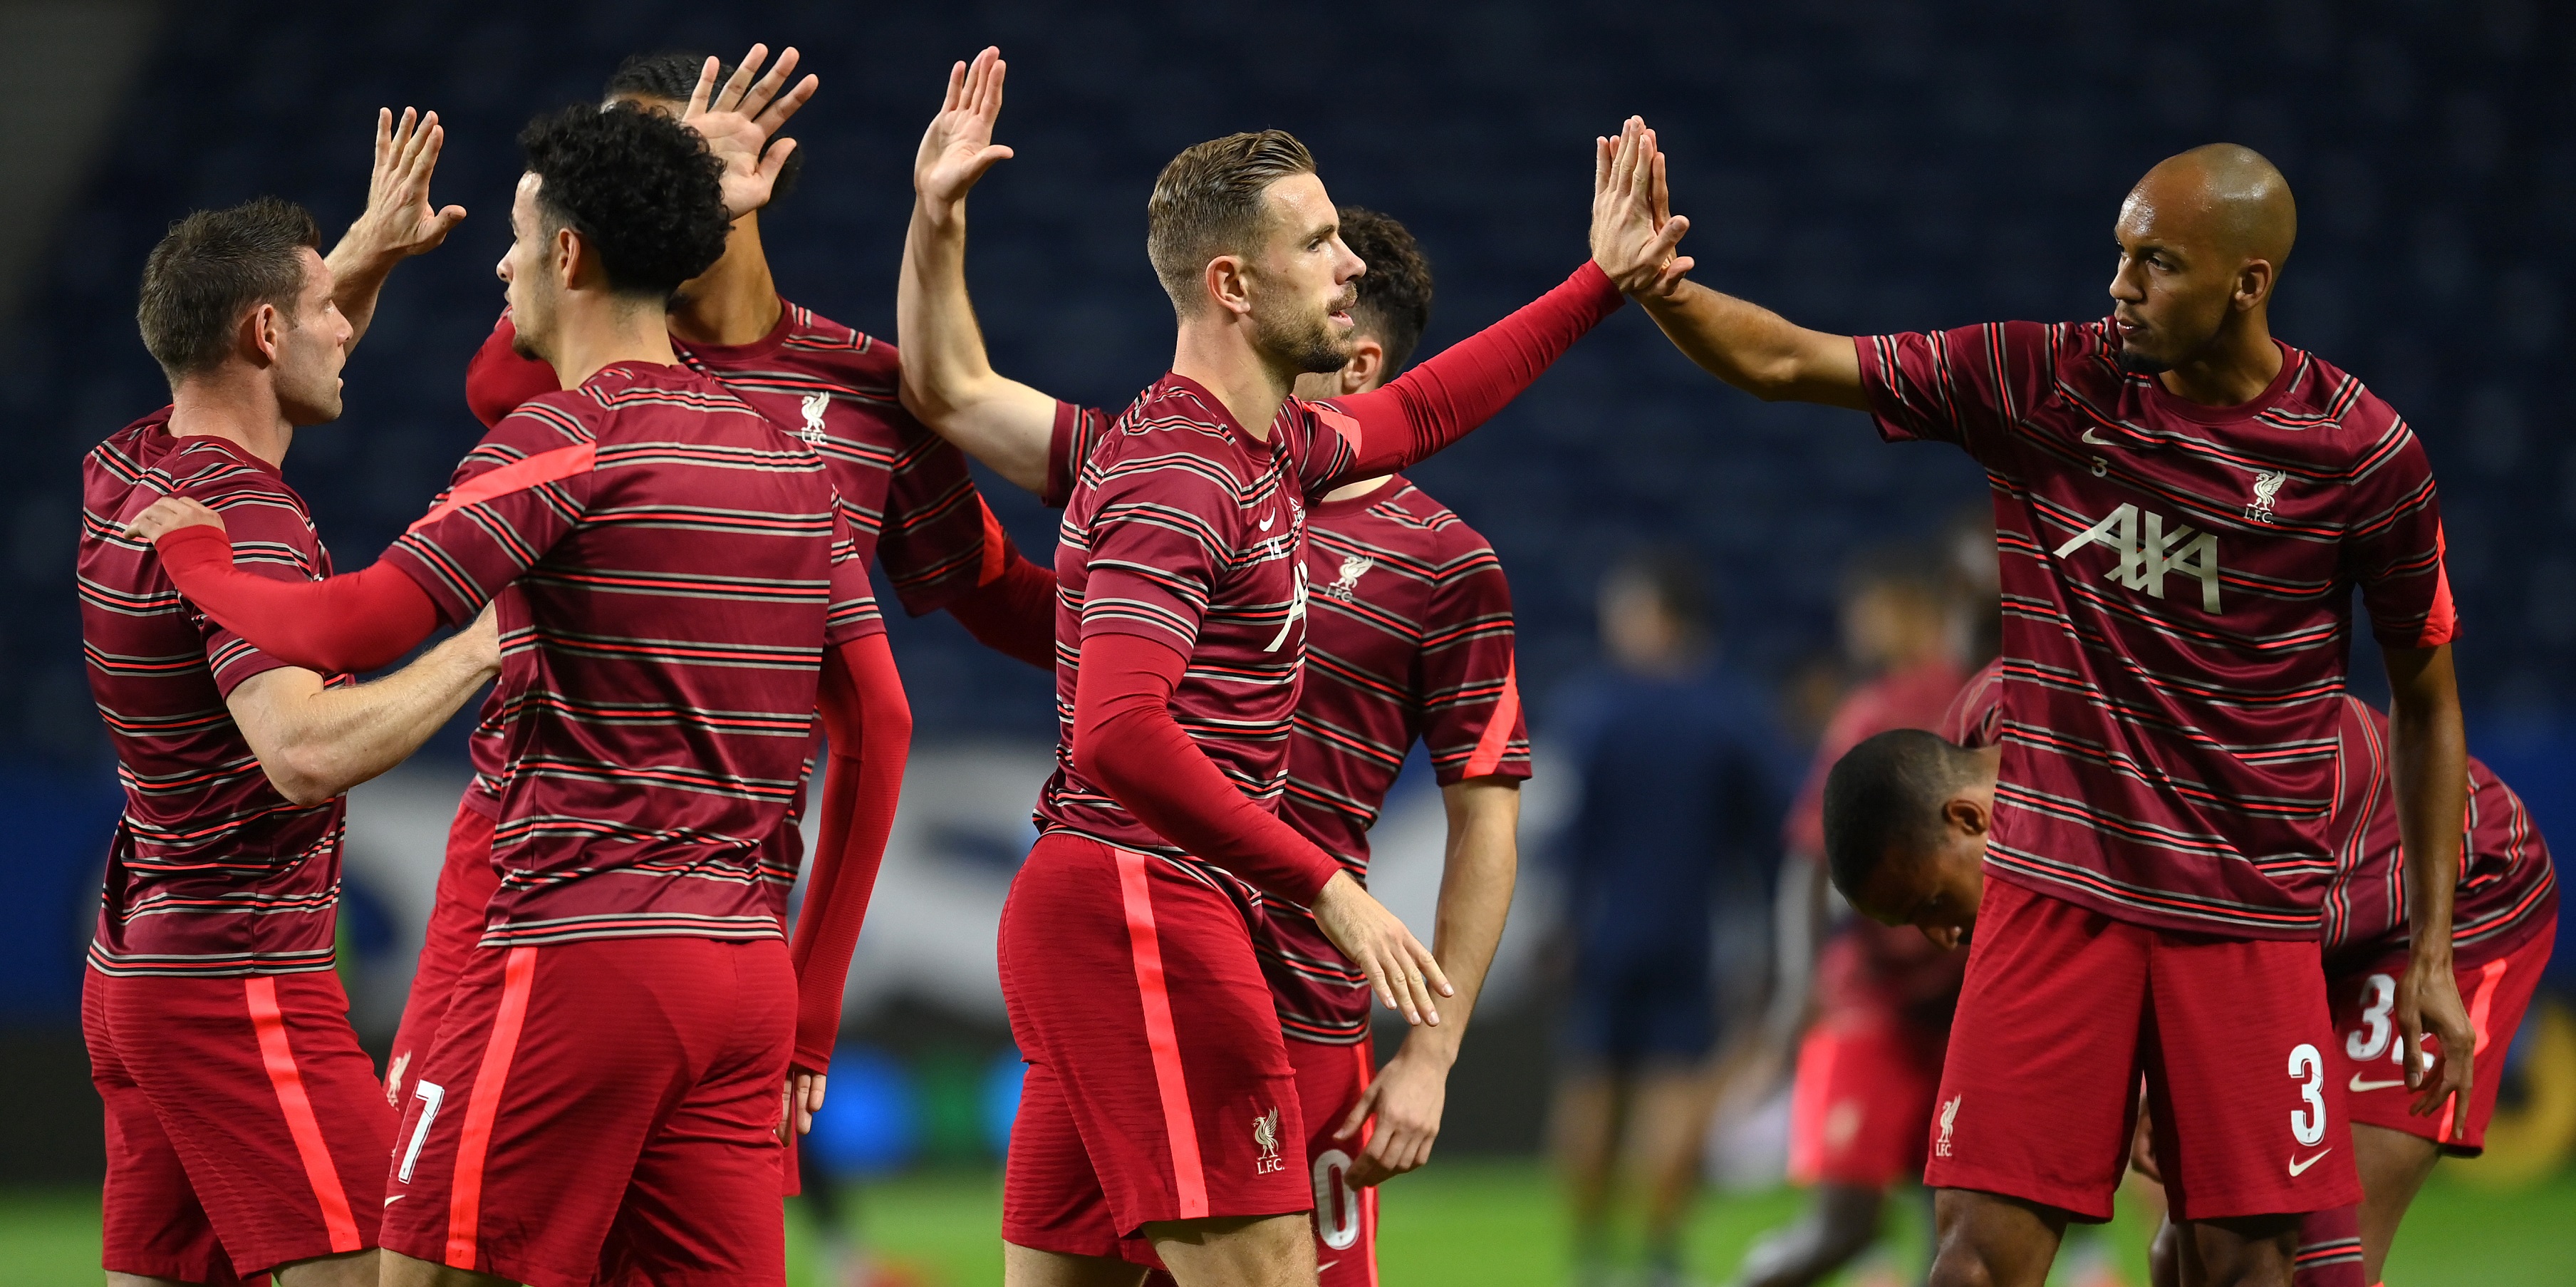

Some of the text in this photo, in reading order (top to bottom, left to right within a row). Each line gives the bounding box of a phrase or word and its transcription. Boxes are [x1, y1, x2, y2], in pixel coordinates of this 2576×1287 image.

[2091, 455, 2109, 477] 3
[1266, 536, 1282, 561] 14
[2052, 502, 2223, 615] AXA
[2288, 1043, 2327, 1147] 3
[1257, 1158, 1285, 1175] L.F.C.
